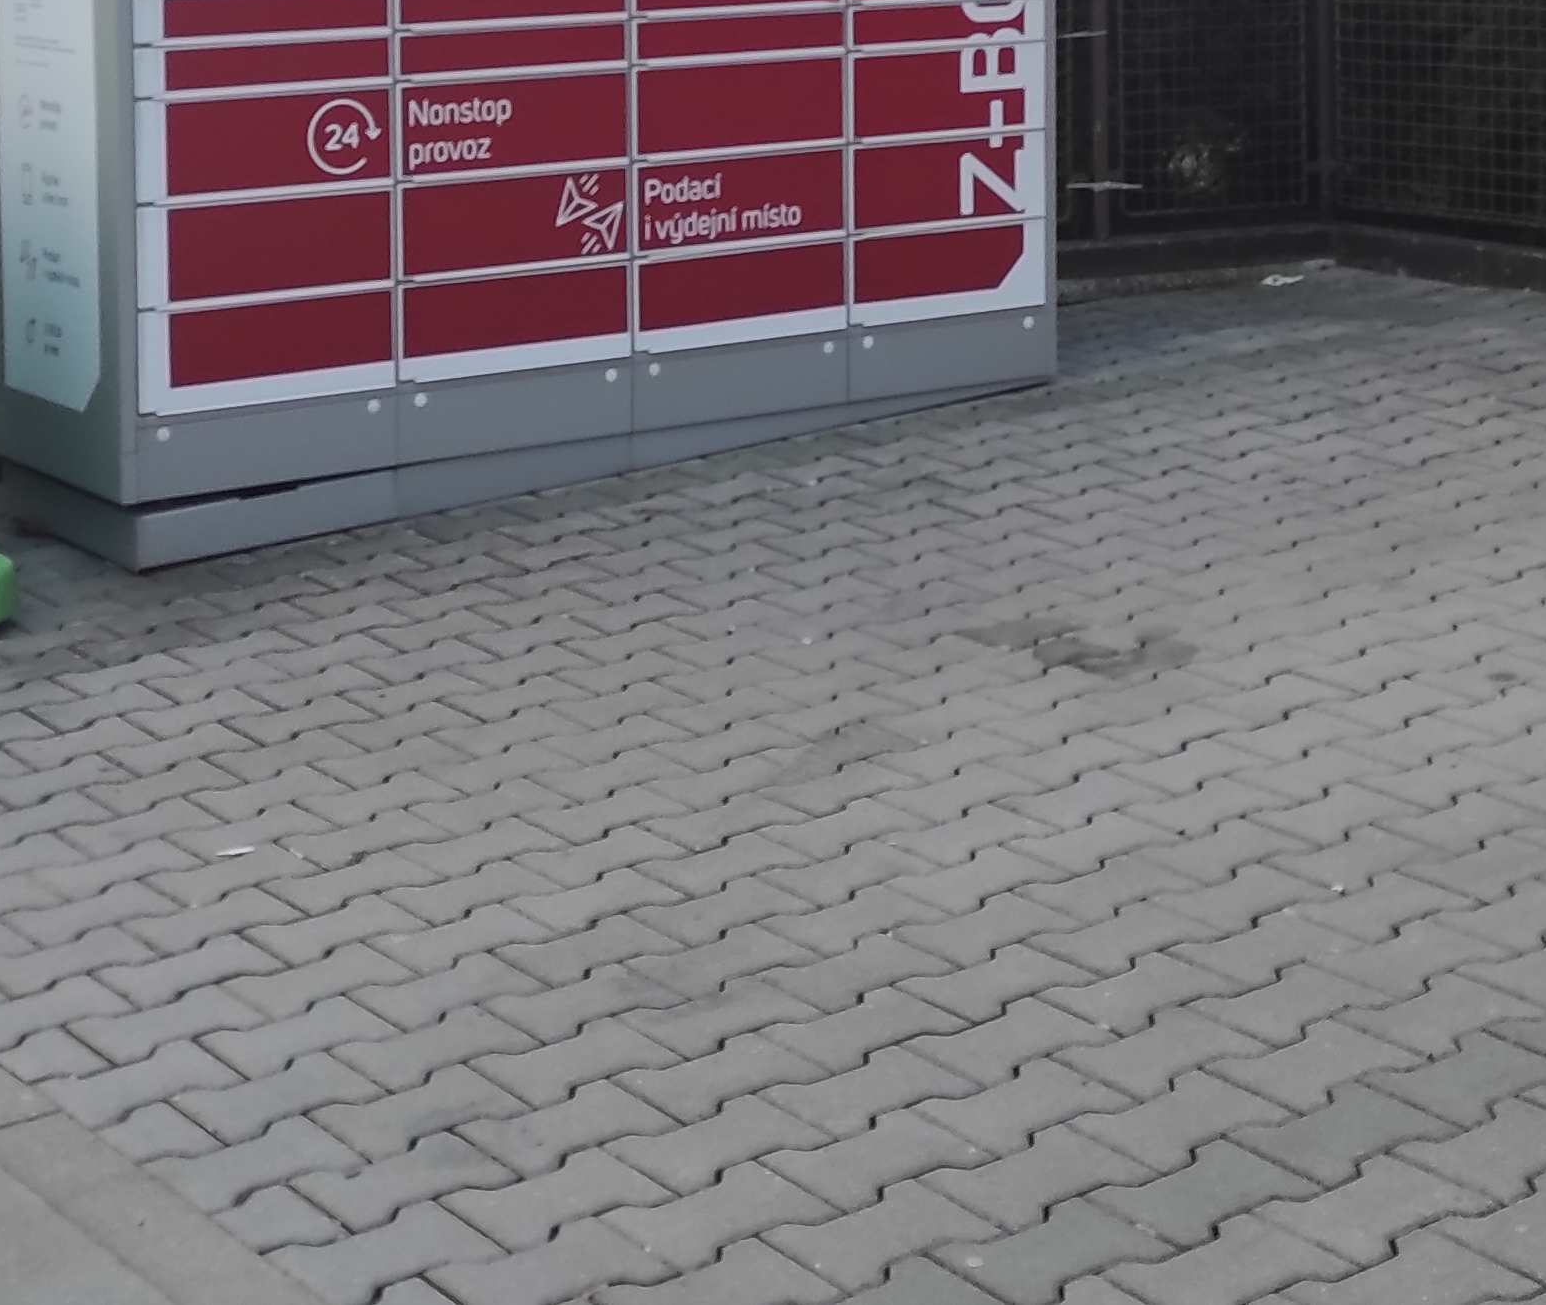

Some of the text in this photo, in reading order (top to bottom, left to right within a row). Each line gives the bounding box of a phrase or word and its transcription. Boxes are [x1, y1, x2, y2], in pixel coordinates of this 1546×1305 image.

[408, 97, 513, 127] Nonstop
[323, 122, 360, 151] 24
[408, 137, 492, 170] provoz
[644, 171, 722, 206] Podací
[643, 202, 802, 245] i výdejní místo
